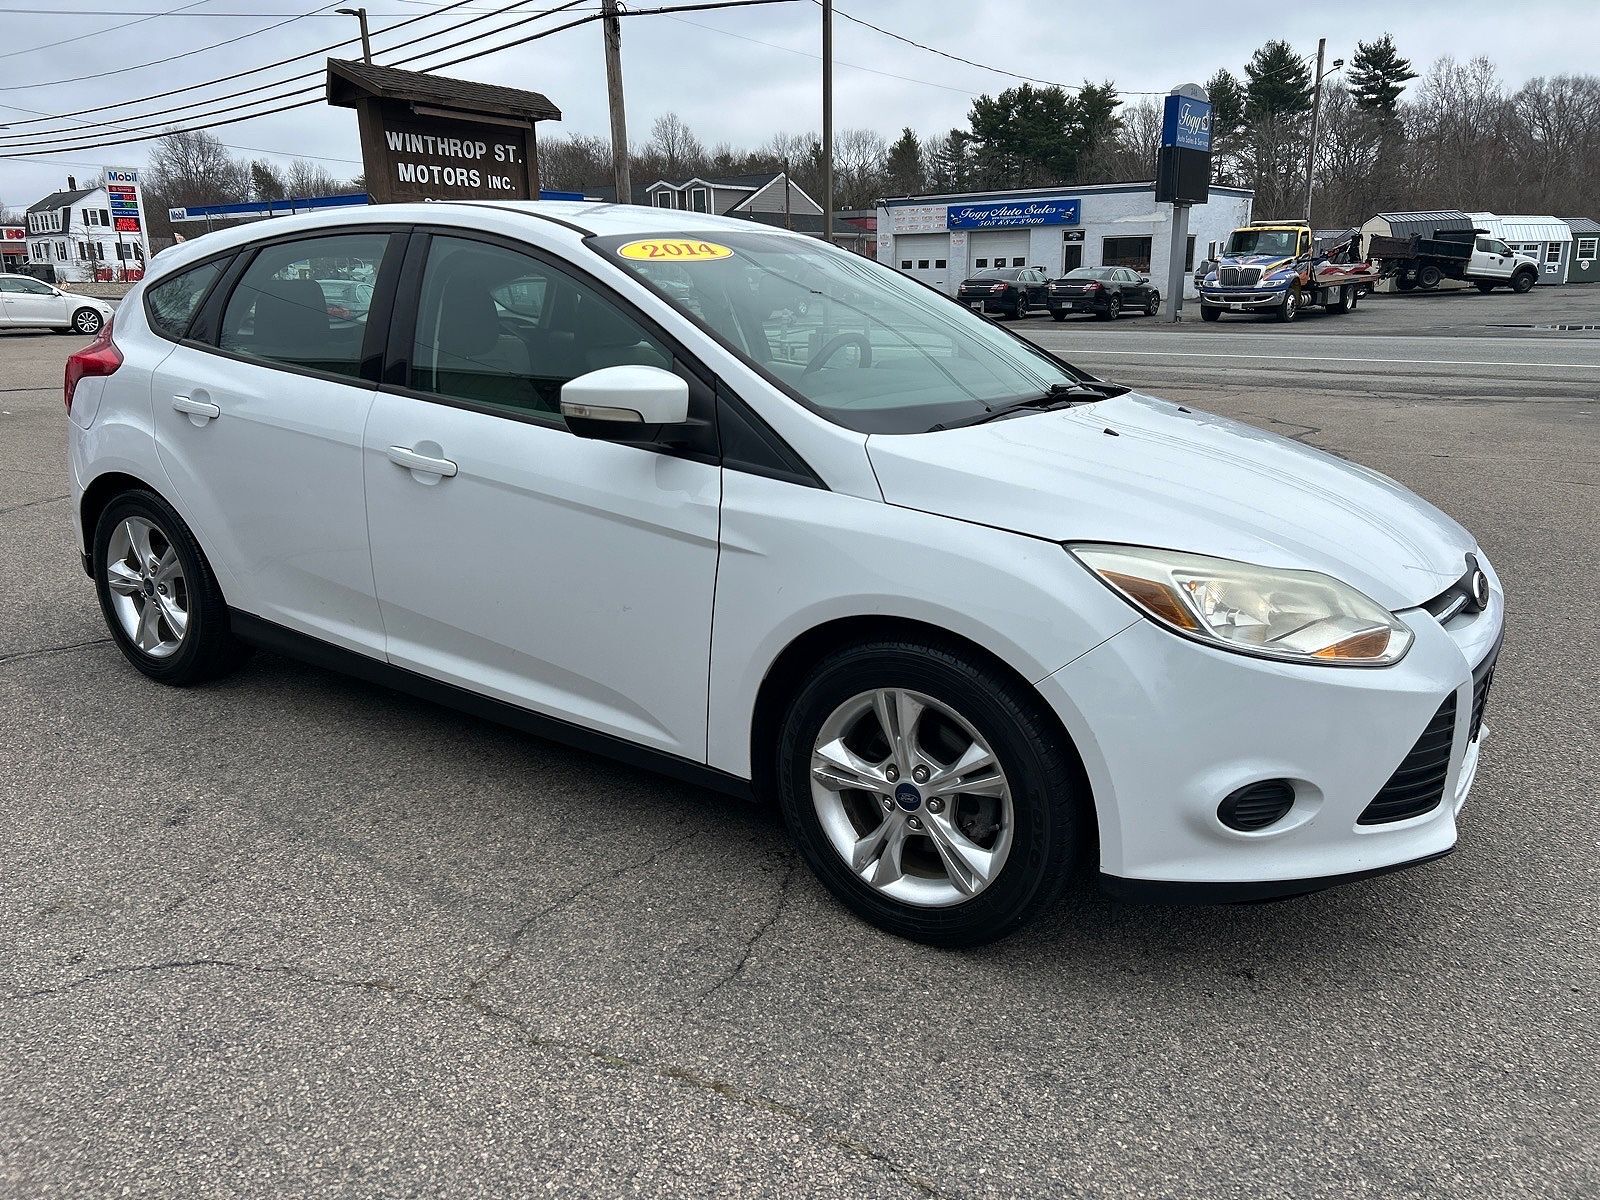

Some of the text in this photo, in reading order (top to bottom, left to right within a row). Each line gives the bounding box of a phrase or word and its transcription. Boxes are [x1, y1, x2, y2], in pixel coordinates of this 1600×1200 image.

[385, 131, 523, 164] WINTHROP ST.
[108, 171, 137, 182] Mobil
[398, 162, 516, 191] MOTORS INC.
[170, 210, 186, 220] Mobil
[990, 206, 1022, 217] Auto
[1024, 203, 1057, 214] Sales
[997, 217, 1045, 226] 884-8900
[642, 244, 718, 257] 2014
